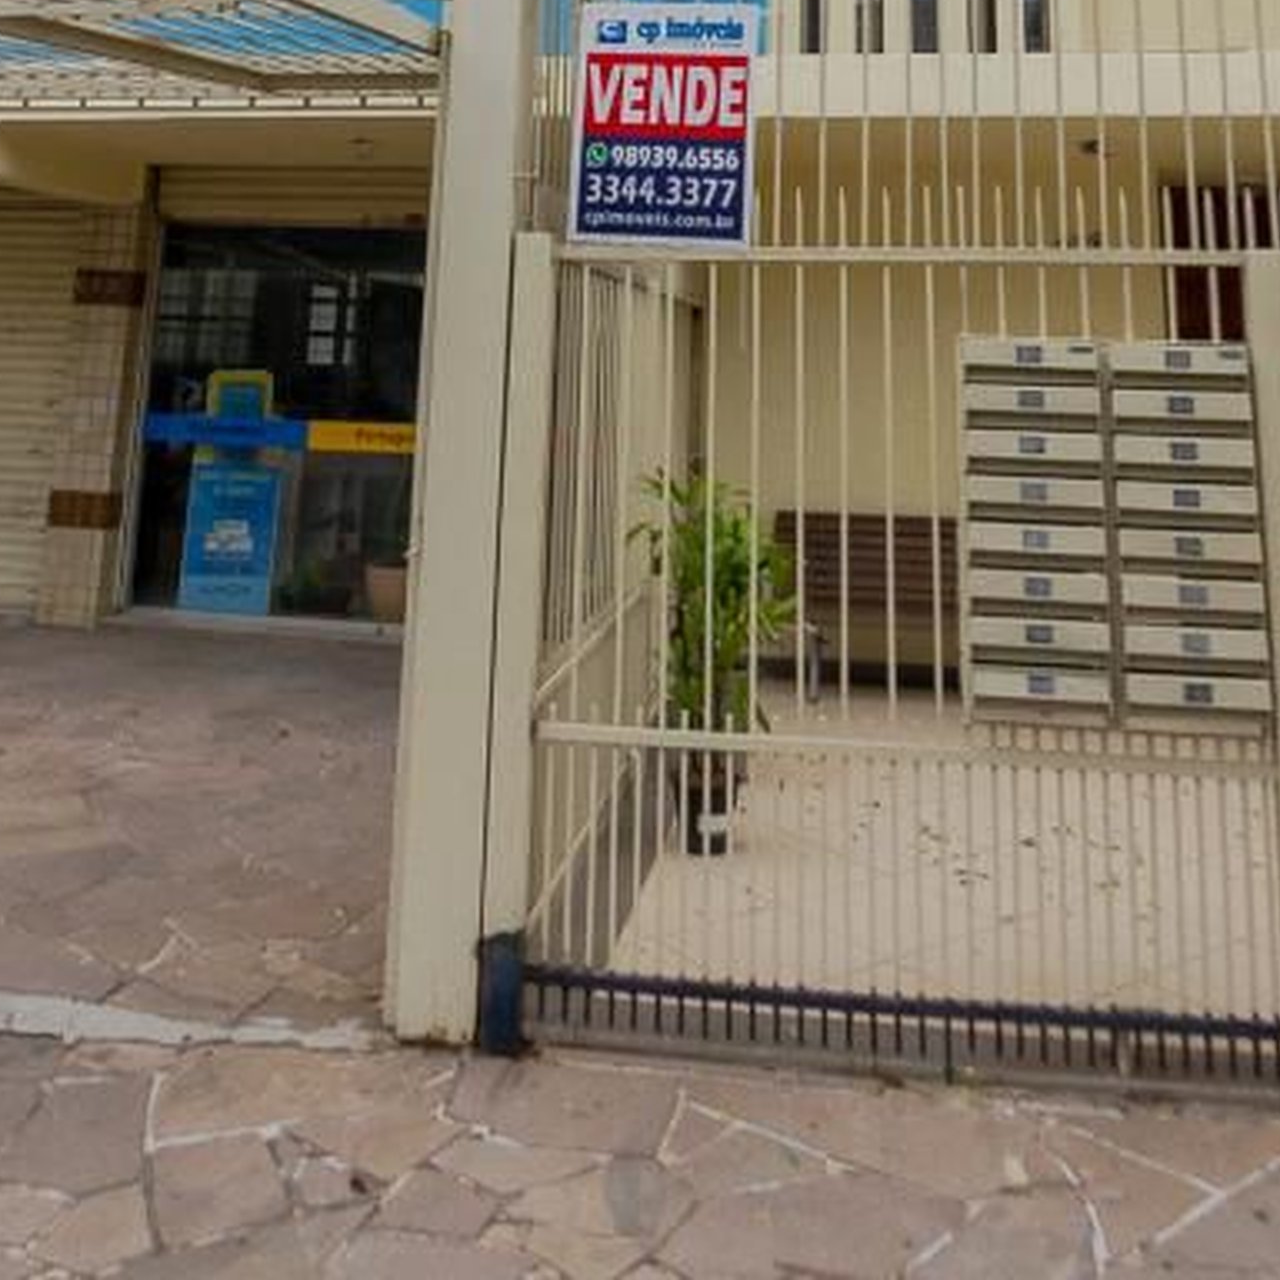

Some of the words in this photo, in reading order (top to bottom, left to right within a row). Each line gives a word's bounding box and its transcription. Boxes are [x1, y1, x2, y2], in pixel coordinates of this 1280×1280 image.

[589, 63, 749, 128] VENDE
[611, 144, 740, 171] 98939.6556
[585, 173, 737, 208] 3344.3377
